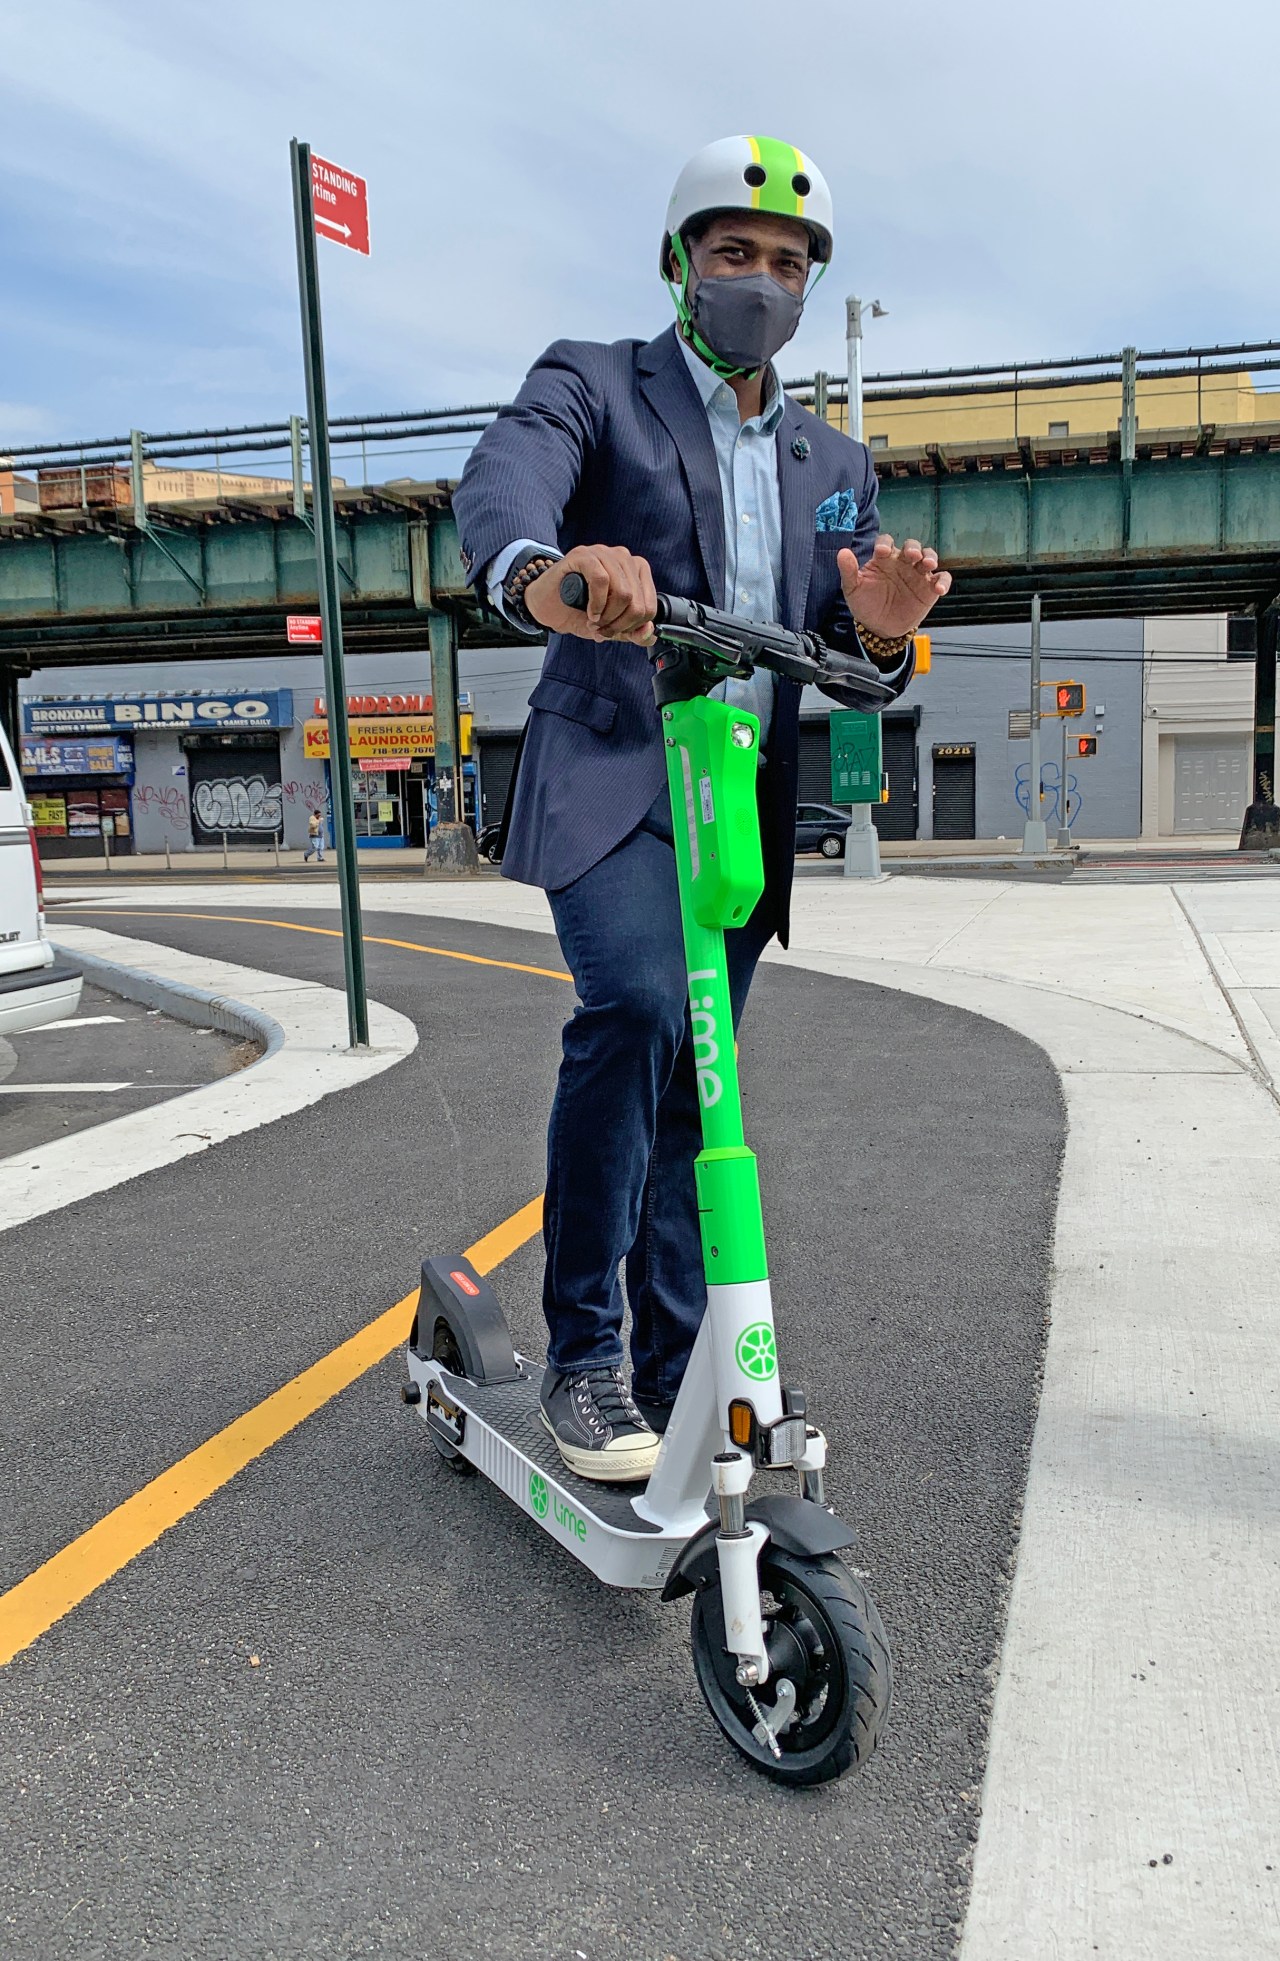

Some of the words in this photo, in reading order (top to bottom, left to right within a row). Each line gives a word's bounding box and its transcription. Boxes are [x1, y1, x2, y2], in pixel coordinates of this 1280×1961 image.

[312, 162, 358, 197] STANDING
[32, 708, 105, 721] BRONXDALE
[114, 700, 269, 722] BINGO
[250, 718, 271, 726] DAILY
[358, 726, 393, 734] FRESH
[938, 746, 971, 755] 2028
[89, 760, 113, 770] SALE
